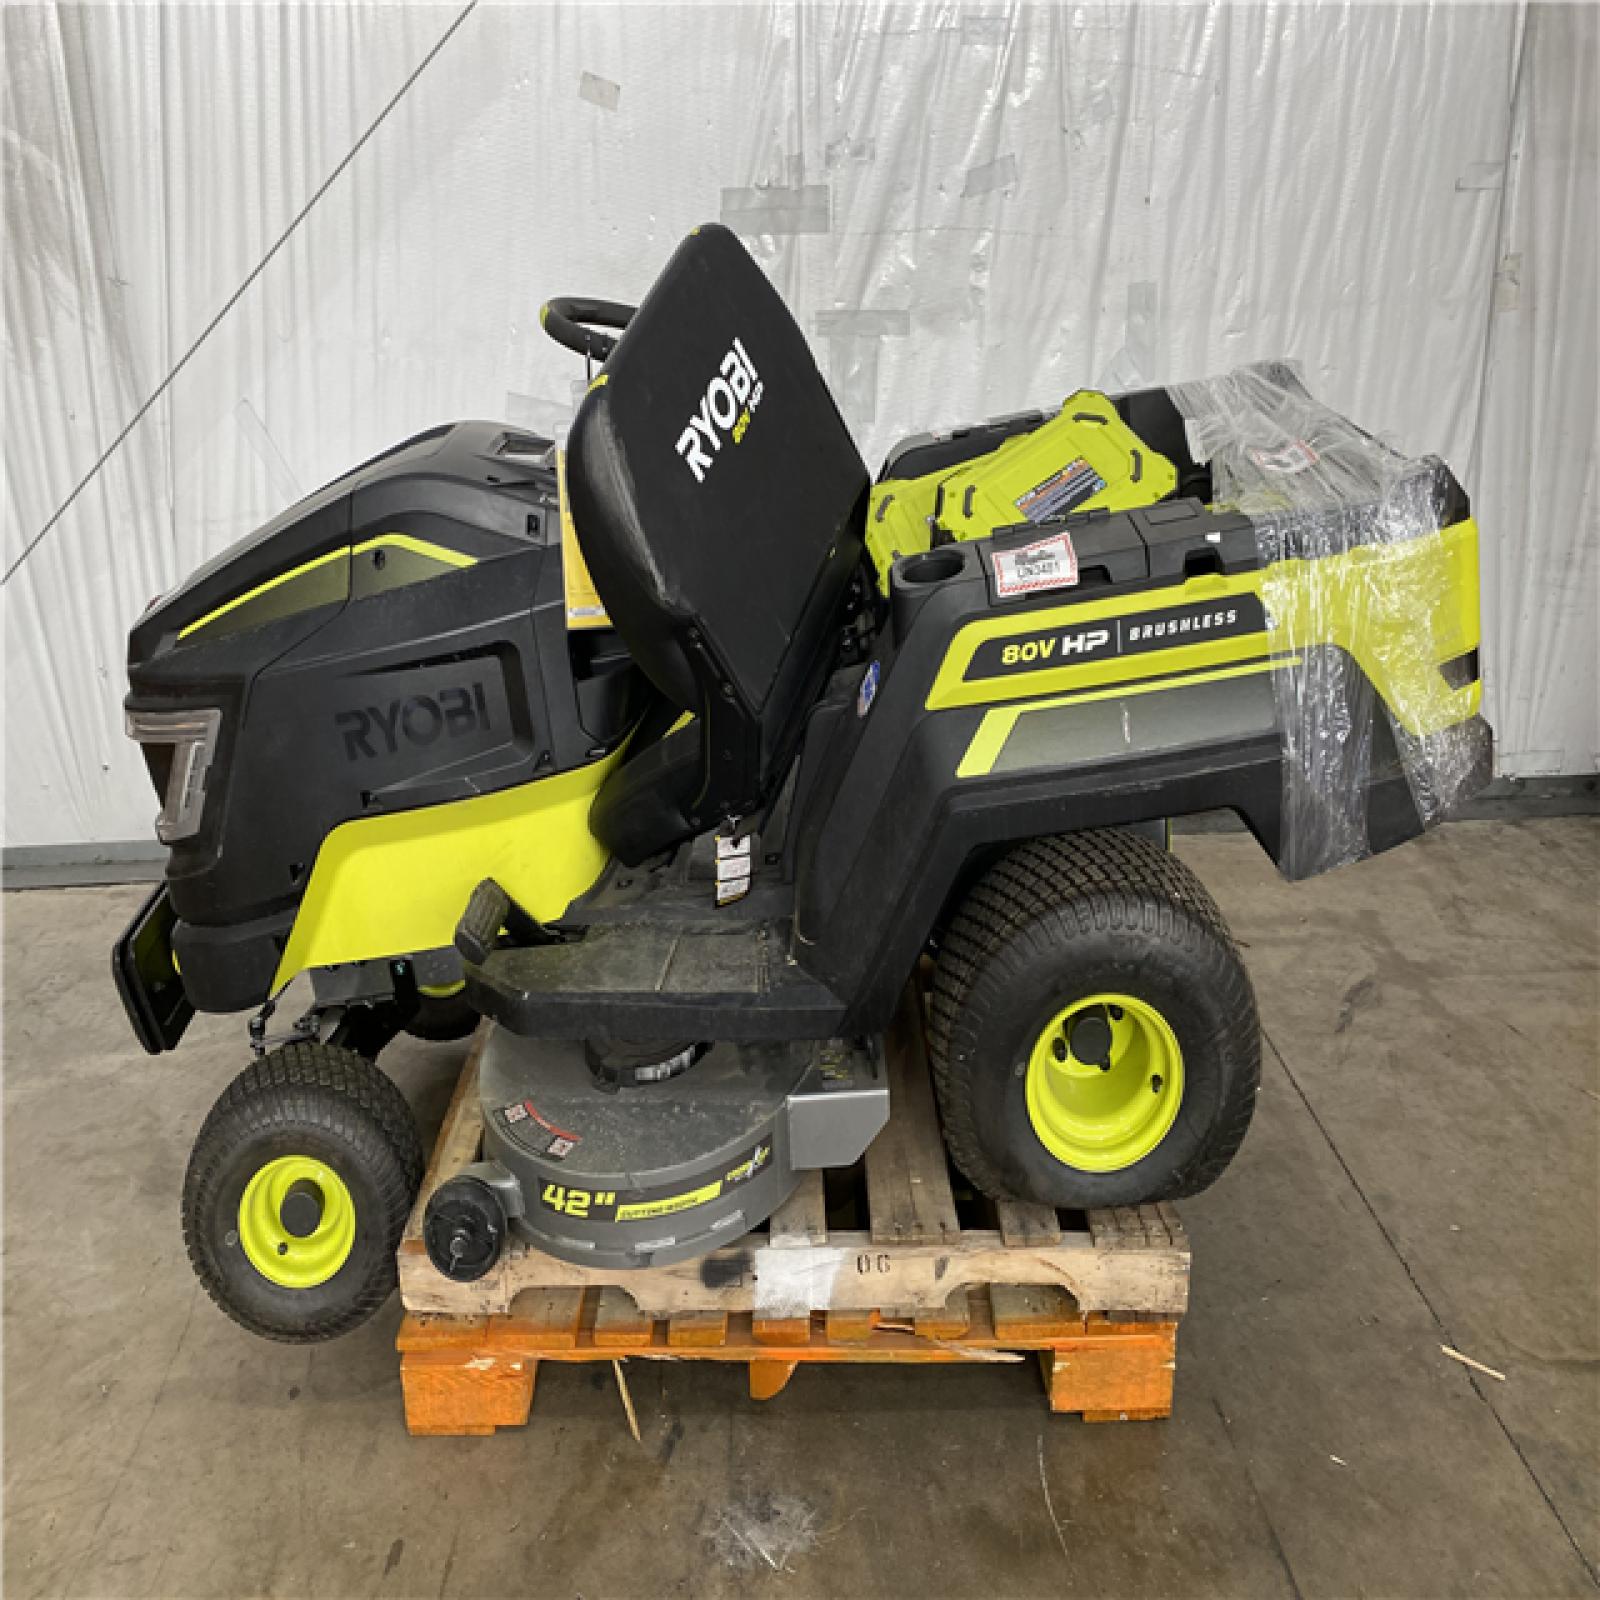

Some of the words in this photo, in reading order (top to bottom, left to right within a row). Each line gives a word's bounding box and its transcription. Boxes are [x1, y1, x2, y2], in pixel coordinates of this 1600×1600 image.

[675, 337, 758, 483] RYOBI
[1002, 639, 1056, 665] 80V
[1061, 629, 1110, 656] HP
[1129, 609, 1238, 641] BRUSHLESS
[334, 682, 491, 761] RYOBI
[542, 1184, 616, 1217] 42"
